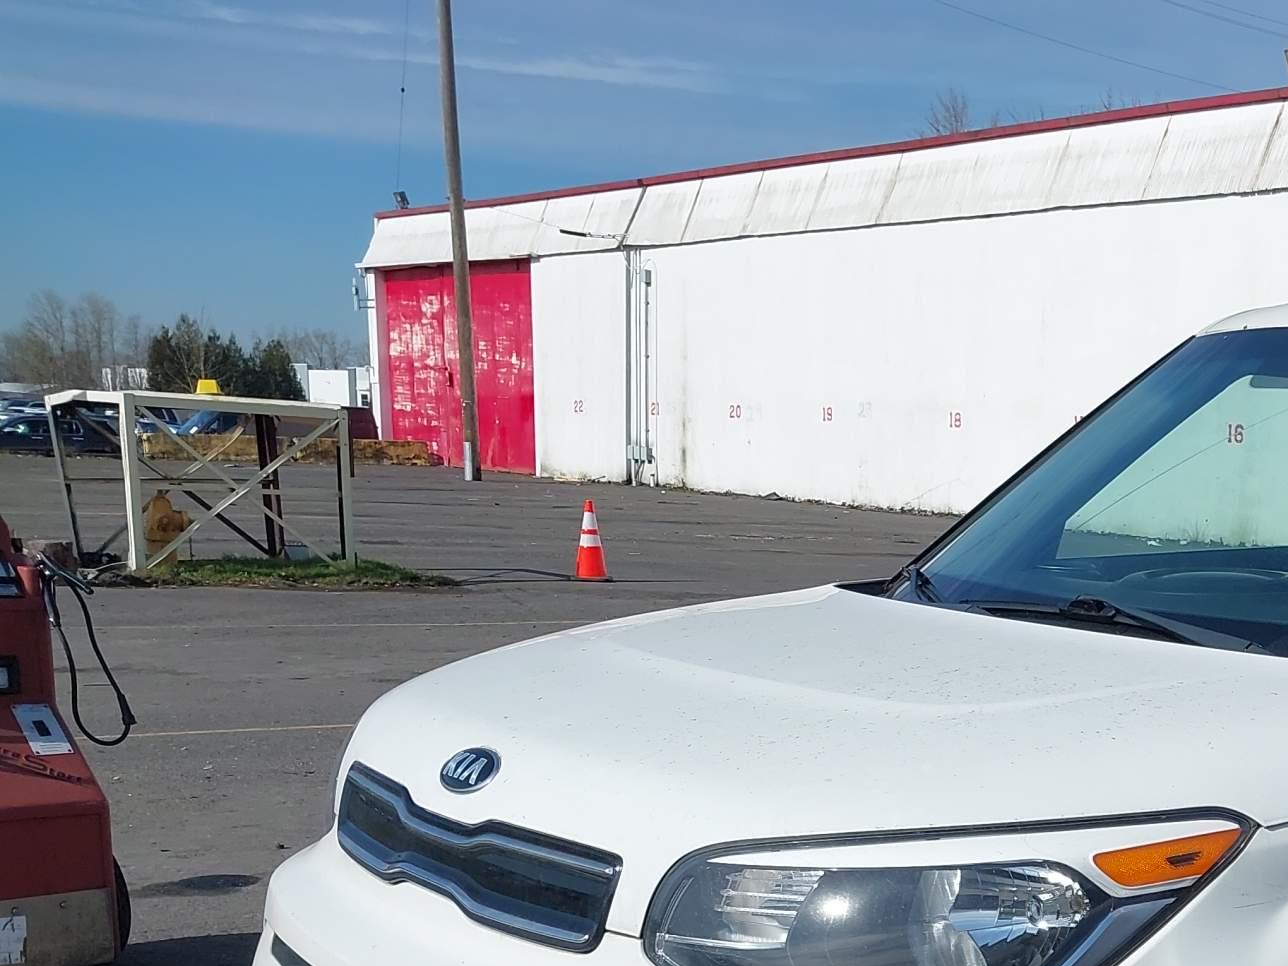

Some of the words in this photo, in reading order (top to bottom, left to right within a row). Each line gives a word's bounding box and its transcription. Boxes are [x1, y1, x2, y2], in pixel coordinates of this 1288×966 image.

[574, 400, 584, 412] 22
[729, 404, 742, 418] 20
[948, 411, 962, 428] 18
[1227, 423, 1244, 443] 16
[442, 751, 488, 785] KIA
